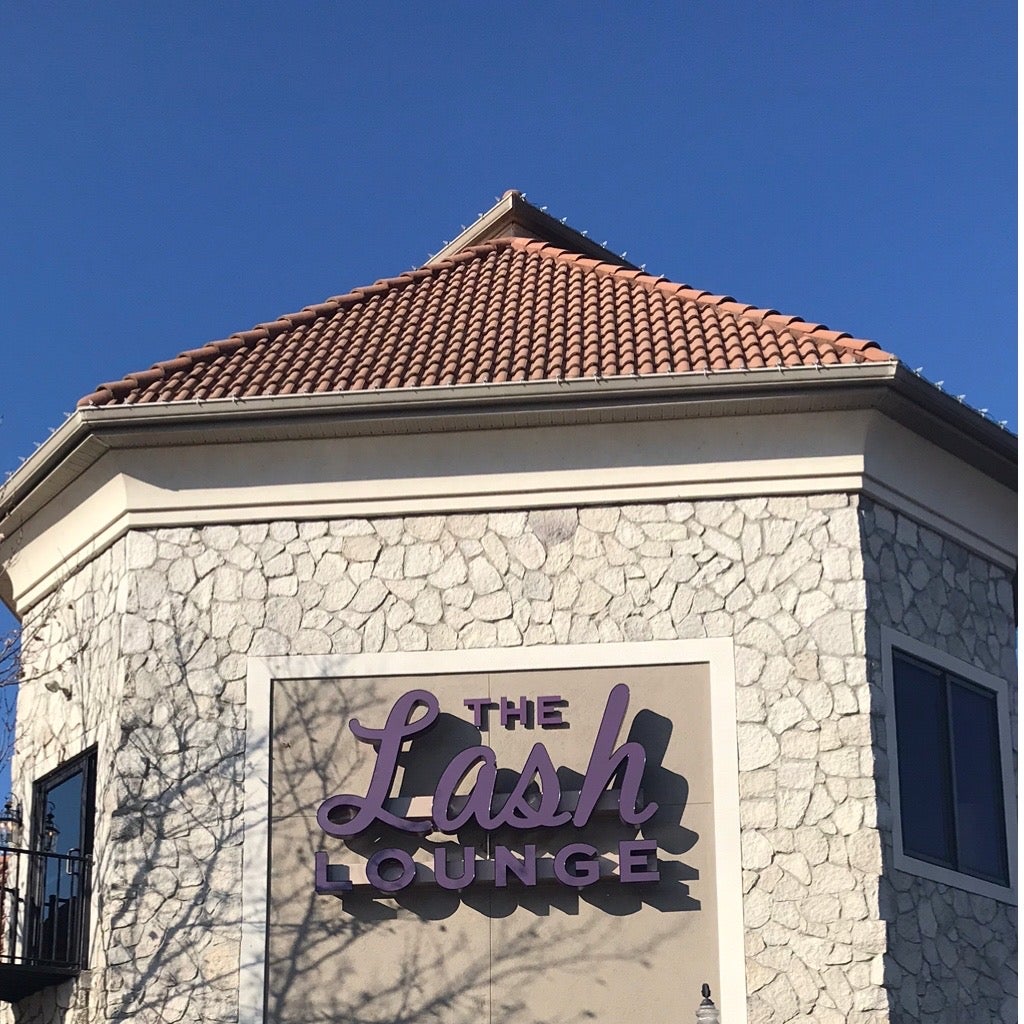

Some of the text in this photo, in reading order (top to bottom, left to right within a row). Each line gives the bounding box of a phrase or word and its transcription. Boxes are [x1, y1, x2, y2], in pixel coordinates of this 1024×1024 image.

[463, 694, 567, 728] THE
[316, 683, 659, 839] Lash
[314, 839, 661, 895] LOUNGE
